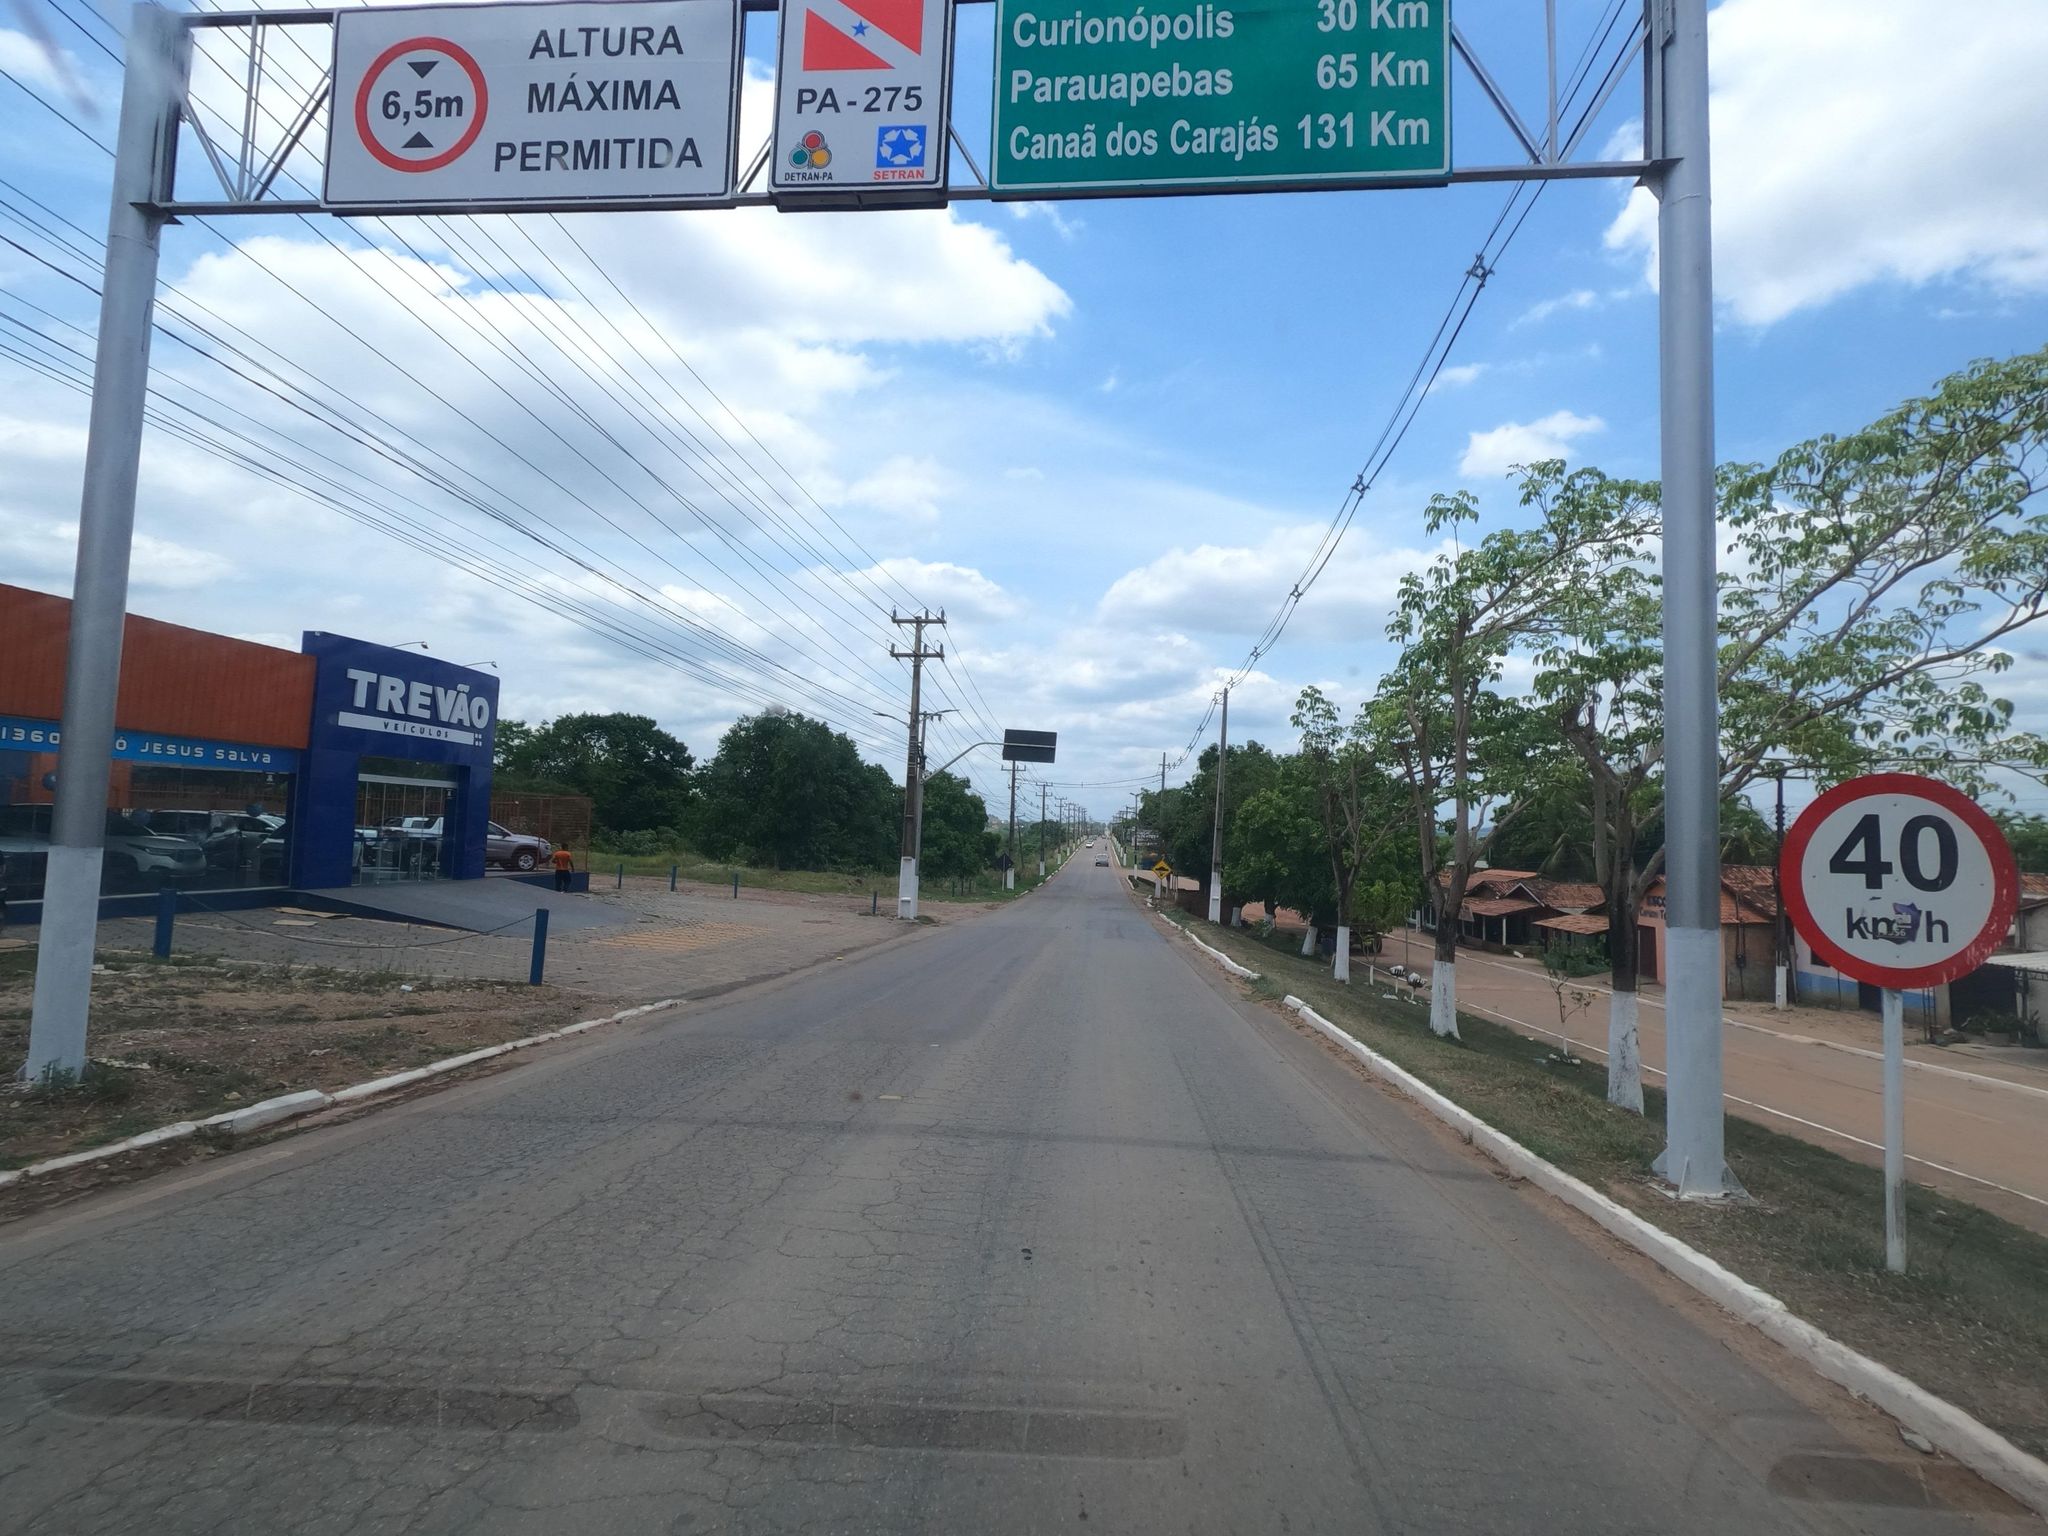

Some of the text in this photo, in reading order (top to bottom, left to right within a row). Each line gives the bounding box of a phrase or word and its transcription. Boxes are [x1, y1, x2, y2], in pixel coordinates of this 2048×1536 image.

[529, 25, 684, 59] ALTURA
[1013, 0, 1429, 49] Curionópolis 30 Km
[527, 72, 681, 113] MÁXIMA
[1010, 52, 1430, 106] Parauapebas 65 Km
[382, 90, 463, 126] 6,5m
[797, 86, 923, 114] PA-275
[1009, 110, 1430, 161] Canaã dos Carajás 131 Km
[494, 137, 702, 172] PERMITIDA
[784, 171, 833, 182] DETRAN-PA
[873, 169, 925, 181] SETRAN
[346, 668, 490, 729] TREVÃO
[383, 721, 449, 739] VEÍCULOS
[140, 741, 205, 758] JESUS
[1829, 814, 1959, 892] 40
